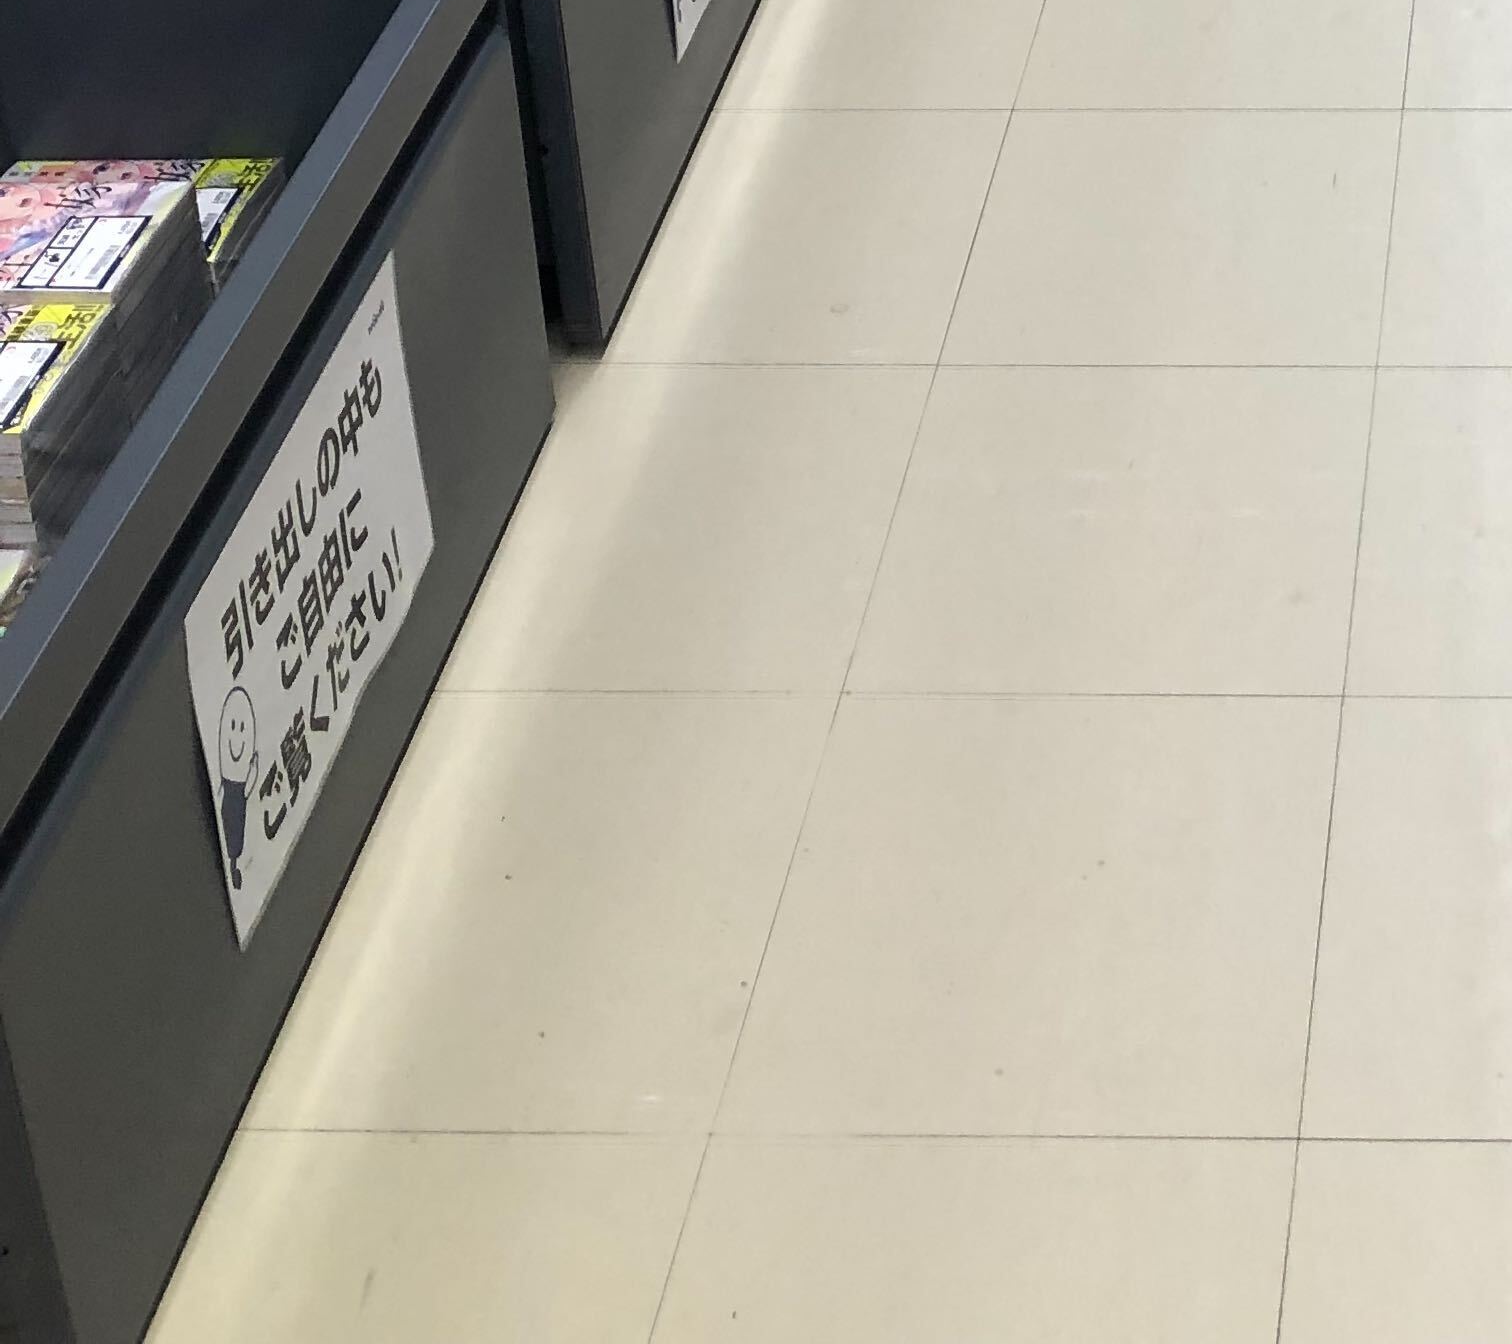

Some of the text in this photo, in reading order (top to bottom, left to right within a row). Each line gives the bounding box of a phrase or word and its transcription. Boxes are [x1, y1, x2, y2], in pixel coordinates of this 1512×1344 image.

[219, 356, 384, 677] 引き出しの中も
[275, 489, 368, 691] ご自由に
[257, 524, 404, 843] ご覧ください!
